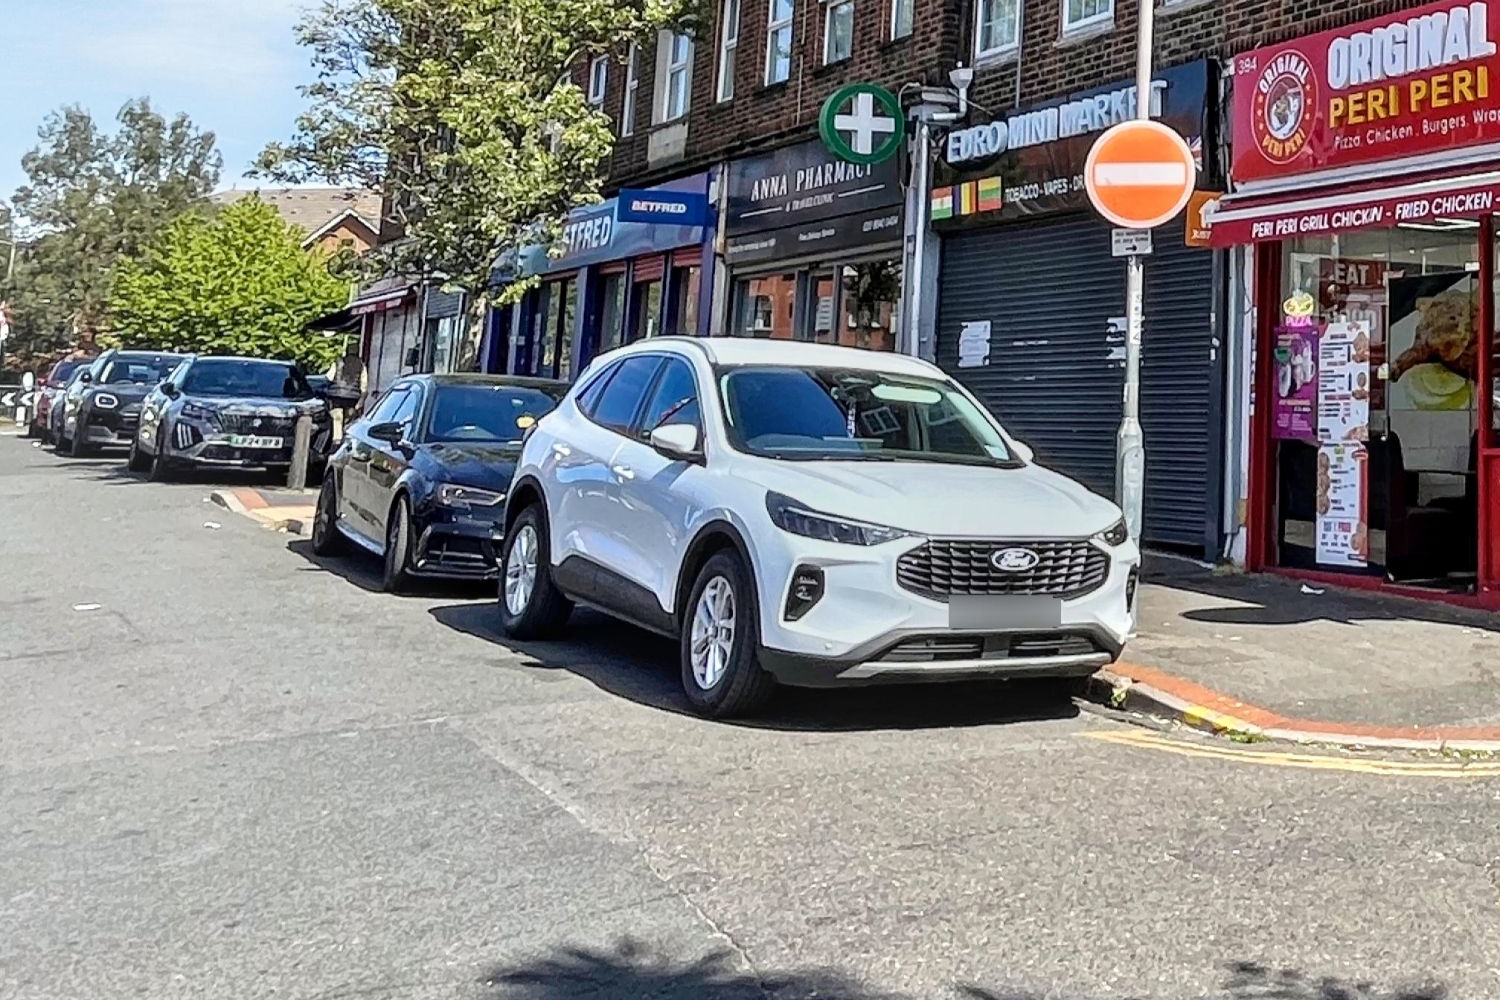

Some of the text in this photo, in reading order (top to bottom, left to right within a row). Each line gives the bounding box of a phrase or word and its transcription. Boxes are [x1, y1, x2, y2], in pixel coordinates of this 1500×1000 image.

[1328, 1, 1497, 90] ORIGINAL
[1259, 54, 1310, 94] ORIGINAL
[1329, 65, 1489, 129] PERI PERI
[947, 119, 1008, 163] EURO
[1008, 107, 1058, 150] MINI
[1334, 135, 1361, 150] Pizza
[1366, 125, 1413, 145] Chicken
[631, 199, 687, 214] BETFRED
[750, 174, 788, 201] ANNA
[562, 215, 612, 253] ETFRED
[1251, 217, 1274, 239] PERI
[1275, 213, 1298, 236] PERI
[1299, 208, 1329, 232] GRILL
[1395, 200, 1429, 220] FRIED
[1431, 192, 1492, 214] CHICKEN
[1334, 262, 1370, 286] EAT
[1285, 316, 1313, 327] PIZZA
